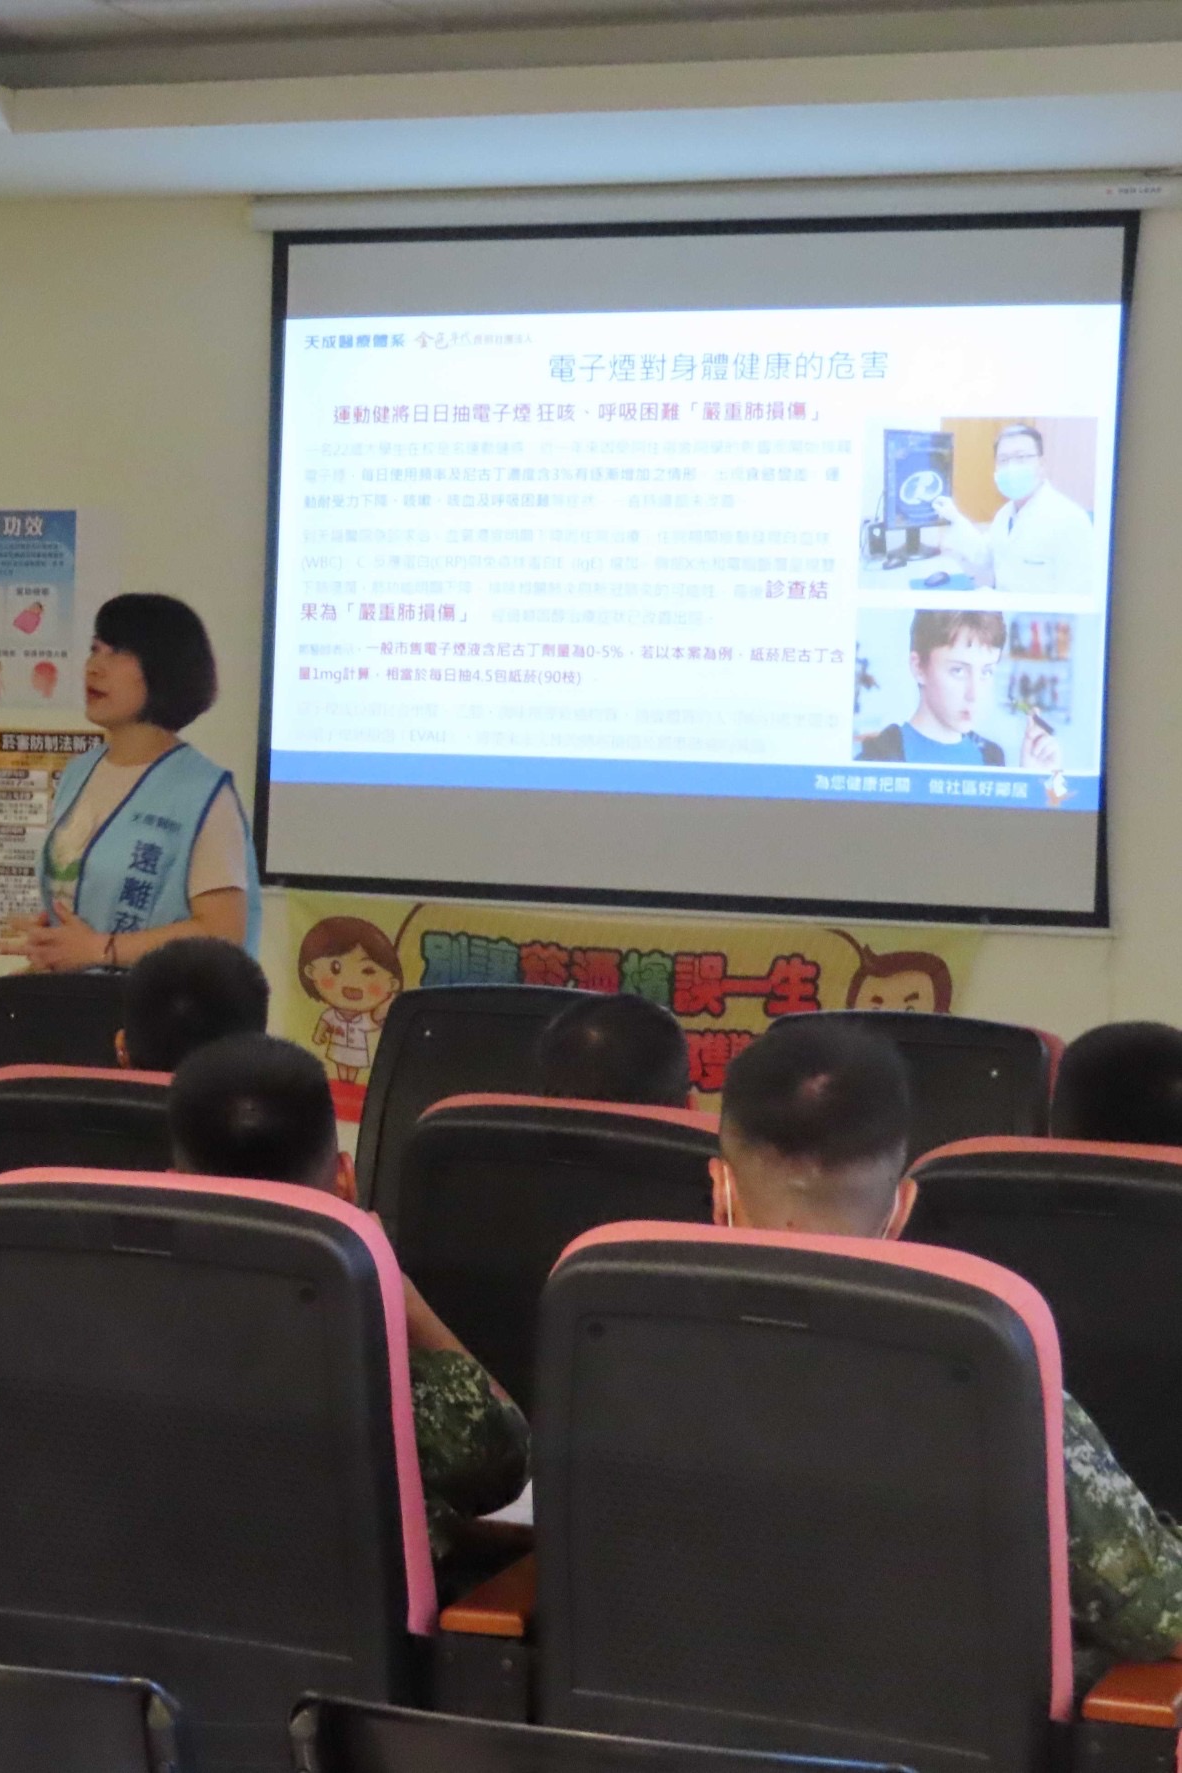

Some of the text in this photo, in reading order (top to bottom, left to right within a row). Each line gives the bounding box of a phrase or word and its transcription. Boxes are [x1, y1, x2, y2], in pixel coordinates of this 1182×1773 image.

[548, 349, 890, 384] 電子煙對身體健康的危害
